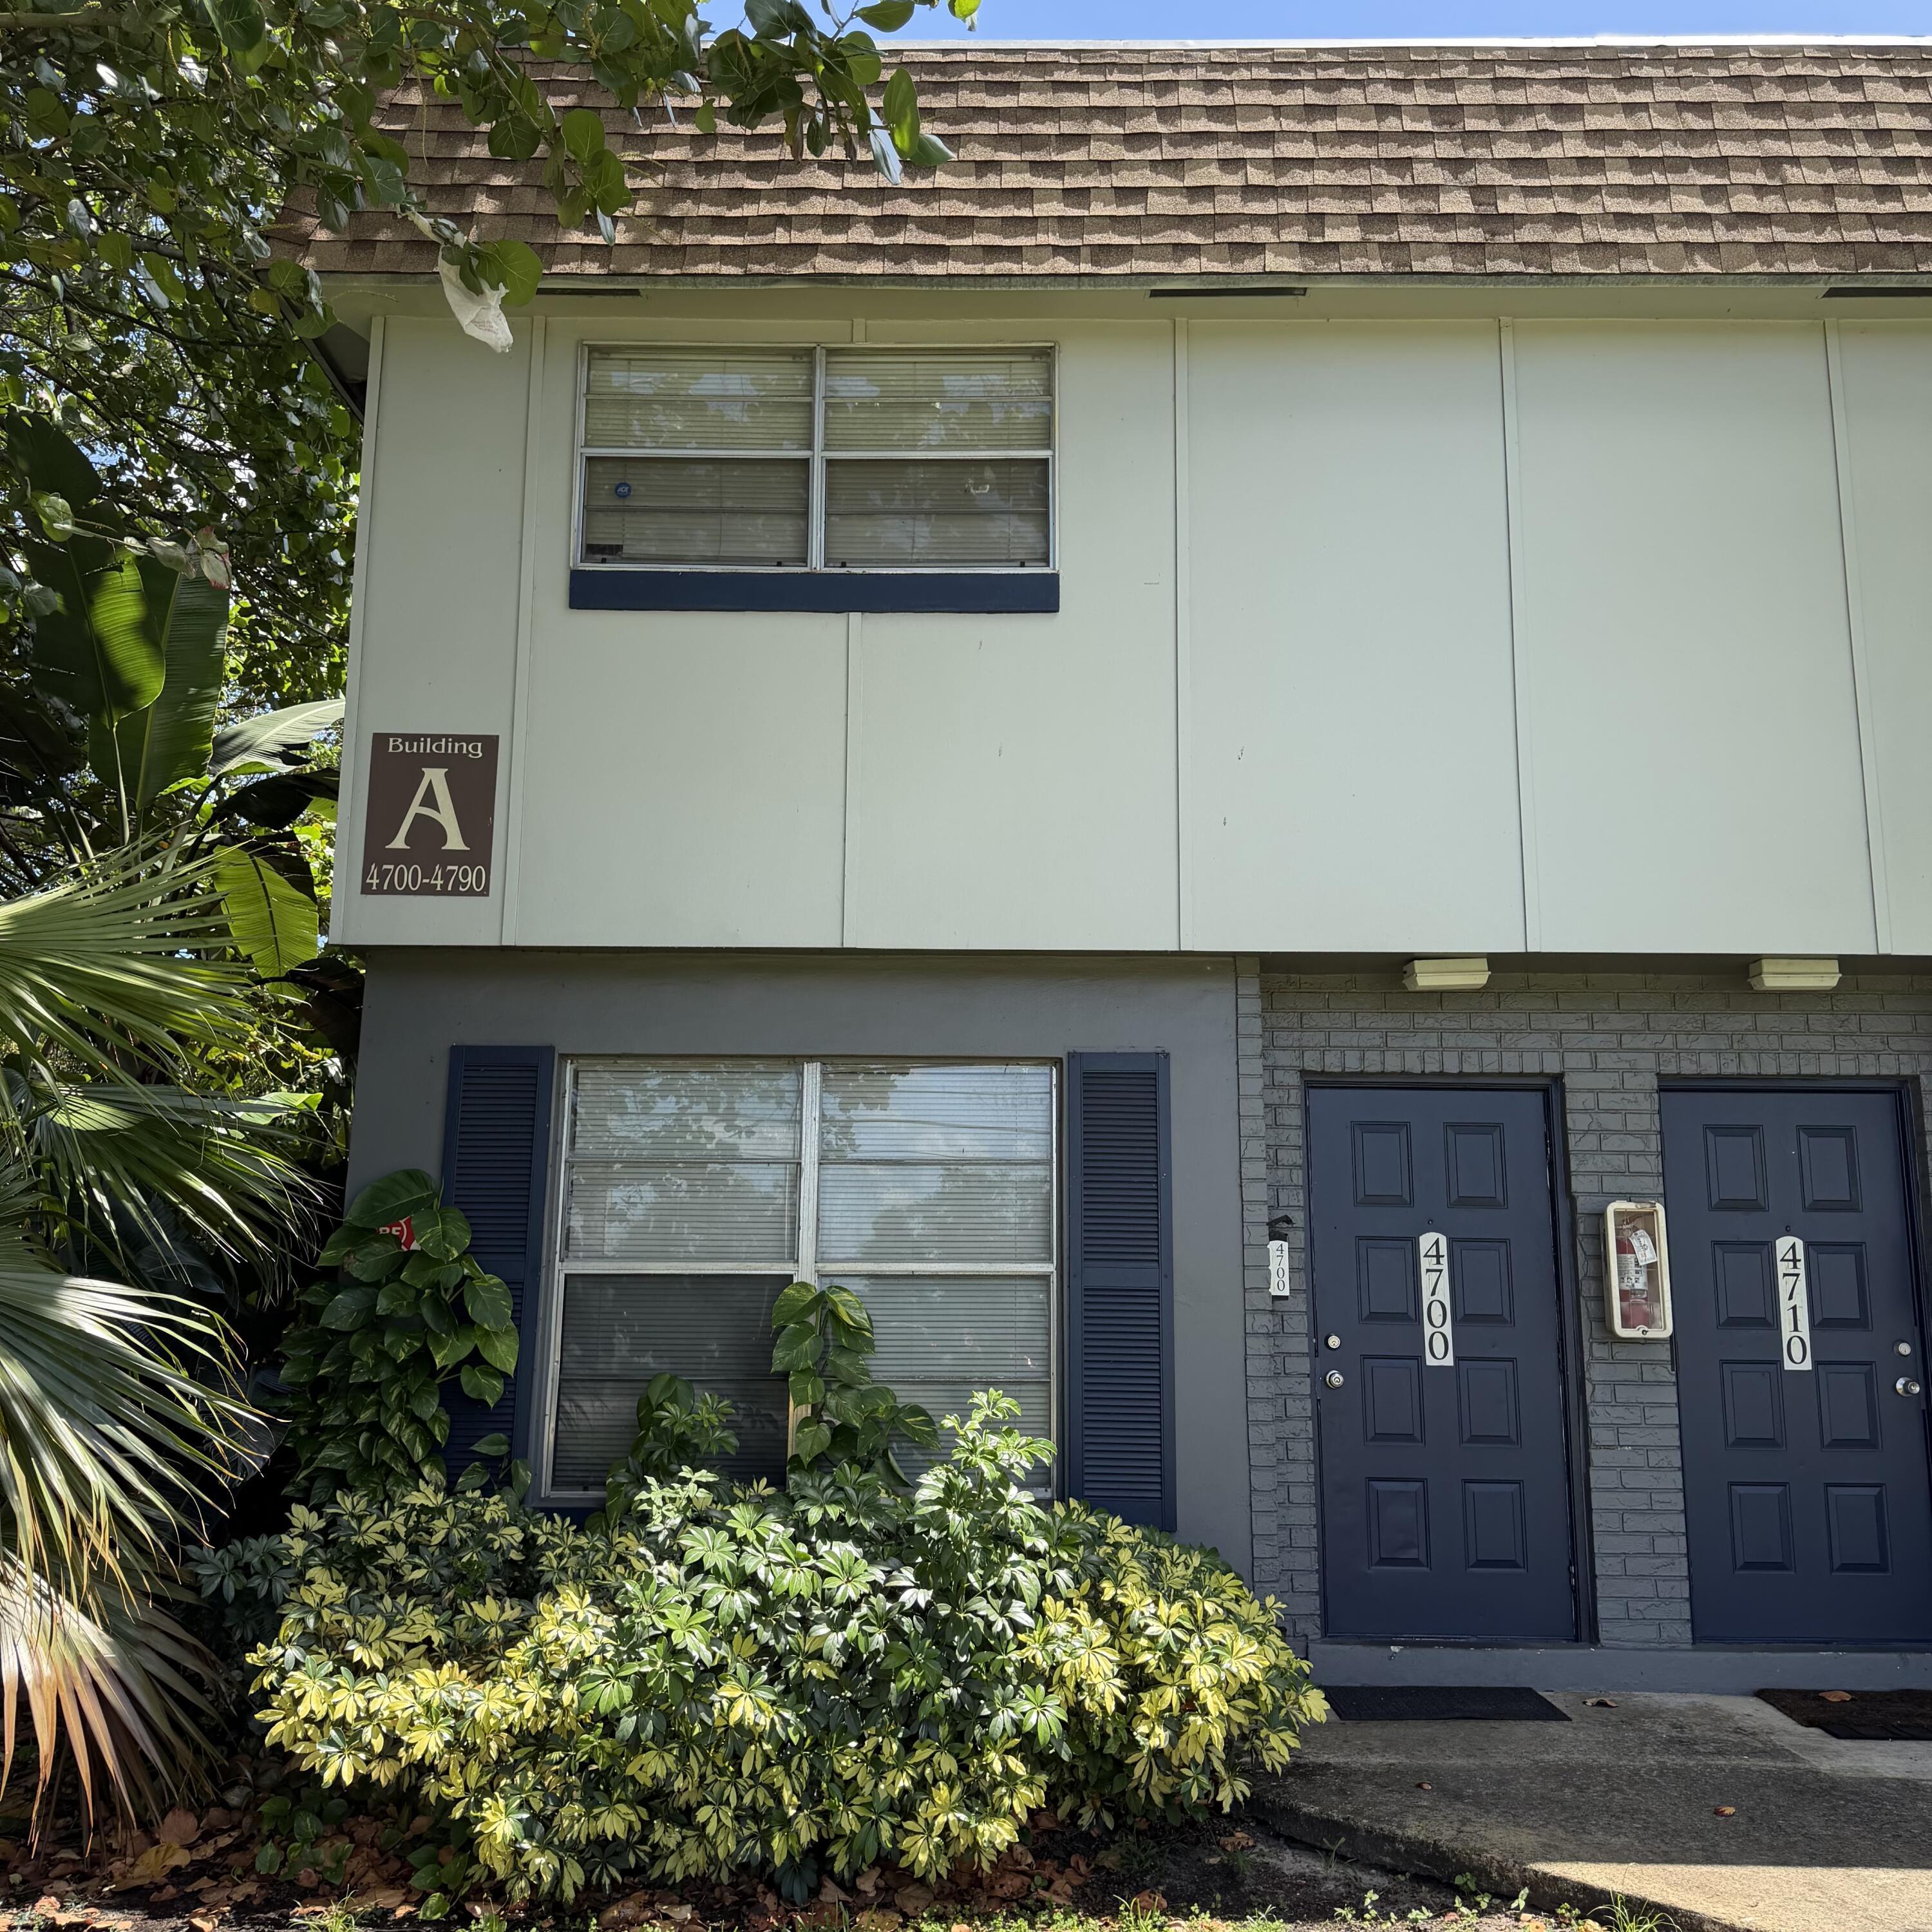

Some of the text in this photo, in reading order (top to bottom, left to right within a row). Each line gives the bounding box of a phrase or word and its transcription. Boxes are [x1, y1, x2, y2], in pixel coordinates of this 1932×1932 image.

[616, 486, 630, 495] ADT
[388, 737, 483, 759] Building
[385, 768, 471, 851] A
[366, 862, 486, 893] 4700-4790
[1276, 1243, 1285, 1292] 4700
[1423, 1236, 1449, 1361] 4700
[1779, 1241, 1807, 1365] 4710
